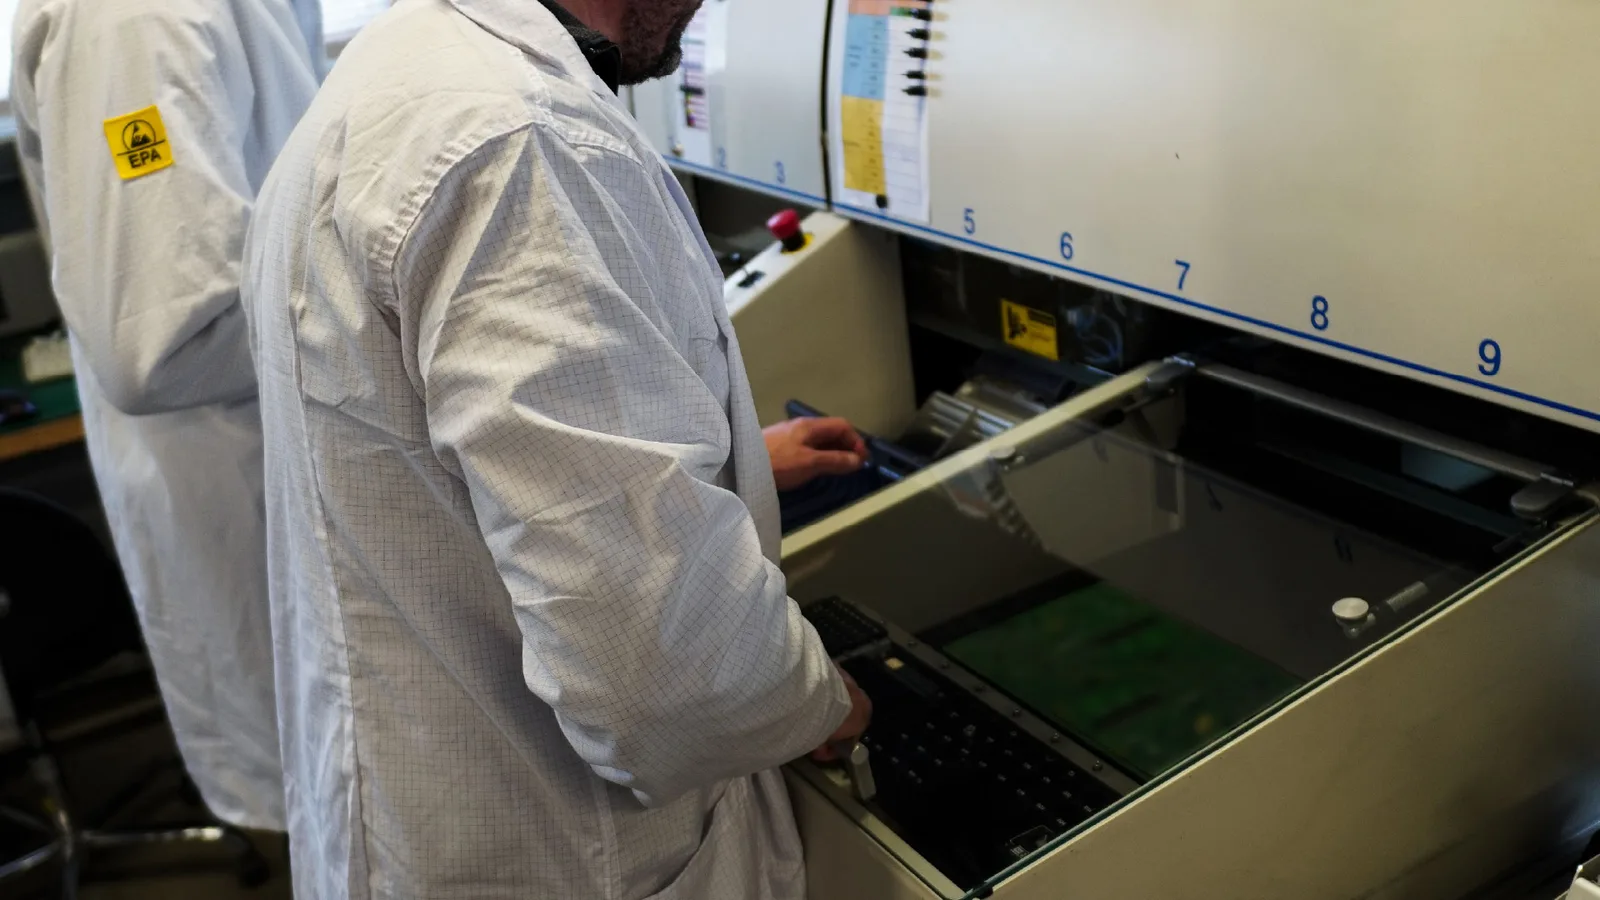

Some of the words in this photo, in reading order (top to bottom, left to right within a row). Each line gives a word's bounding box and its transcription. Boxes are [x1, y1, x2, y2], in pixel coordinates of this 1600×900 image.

[128, 148, 162, 168] EPA
[963, 207, 976, 235] 5
[1060, 231, 1073, 260] 6
[1175, 260, 1192, 290] 7
[1310, 295, 1329, 331] 8
[1478, 338, 1502, 376] 9
